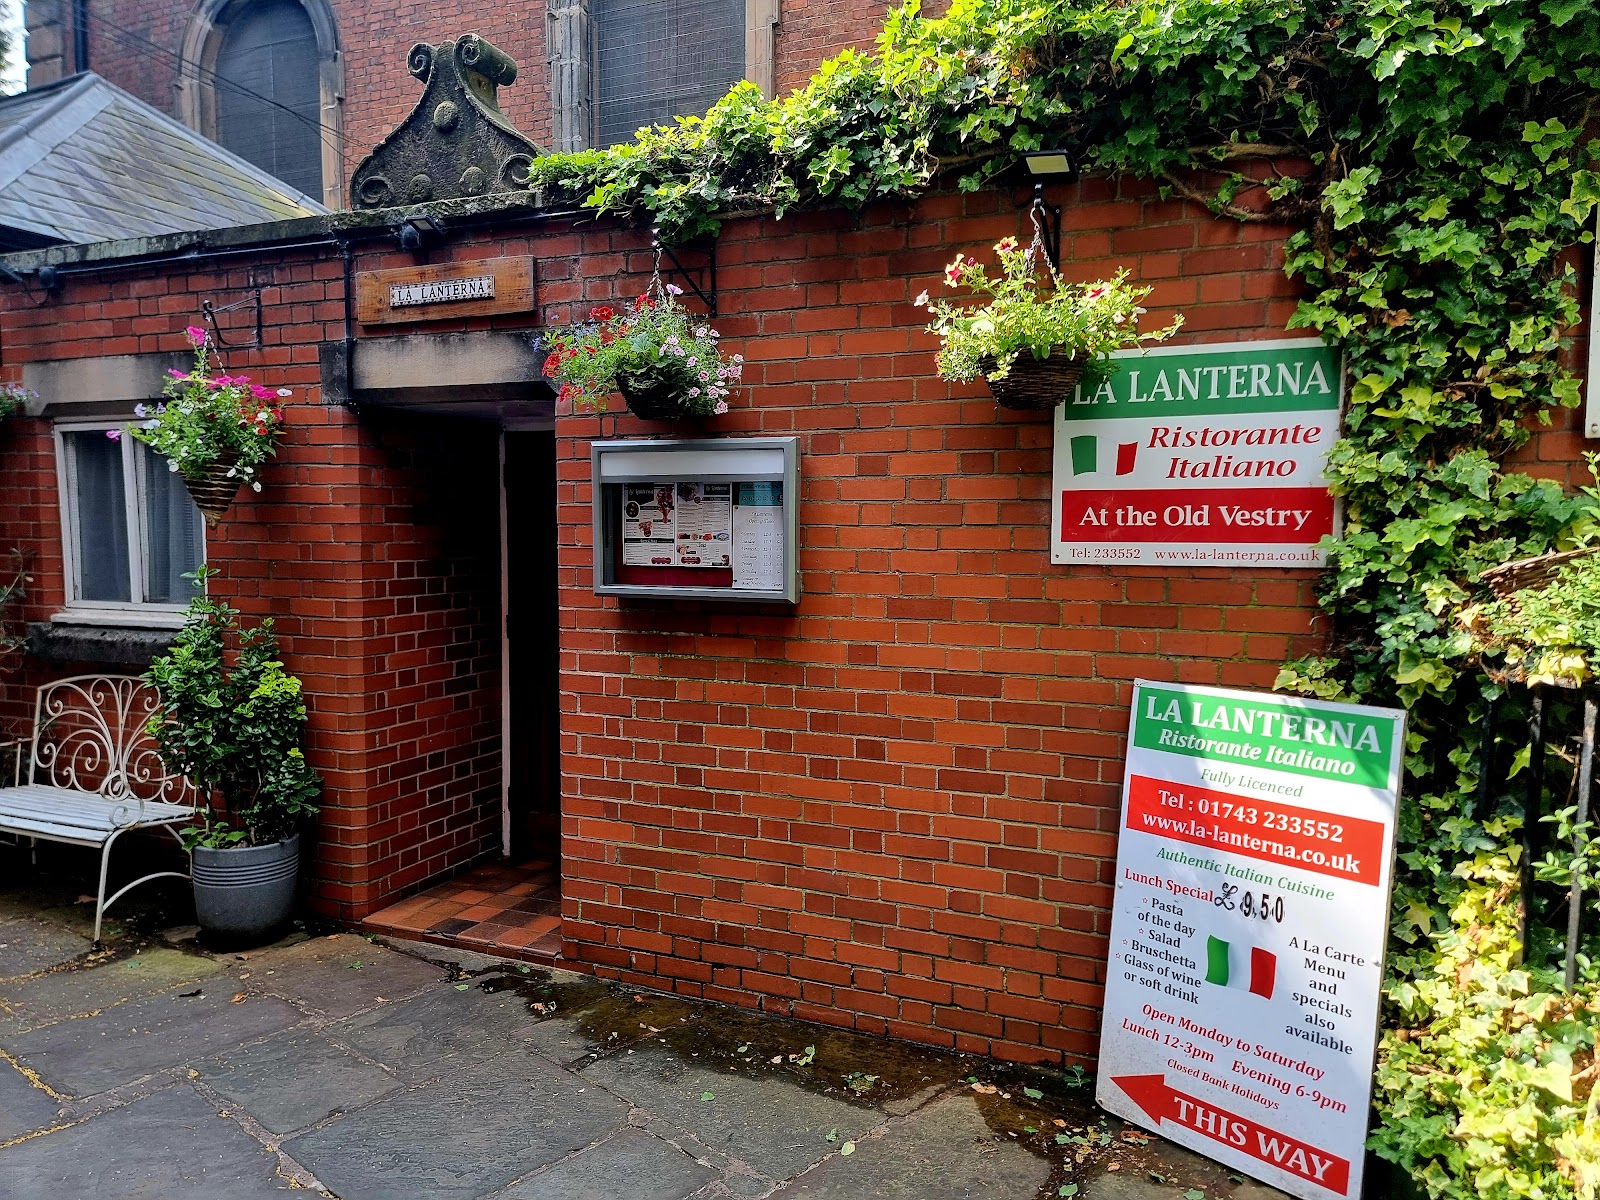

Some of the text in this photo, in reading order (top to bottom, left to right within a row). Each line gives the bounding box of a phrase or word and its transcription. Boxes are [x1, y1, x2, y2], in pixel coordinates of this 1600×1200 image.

[398, 282, 485, 301] LA LANTERNA
[1072, 360, 1332, 406] LA LANTERNA
[1146, 424, 1322, 449] Ristorante
[1166, 455, 1298, 479] Italiano
[1079, 504, 1312, 531] At the Old Vestry
[1070, 548, 1320, 562] Tel: 233552 www.la-lanterna.co.uk
[1145, 696, 1382, 754] LA LANTERNA
[1158, 728, 1356, 776] Ristorante Italiano
[1200, 767, 1304, 798] Fully Licenced
[1158, 789, 1184, 810] Tel
[1198, 799, 1257, 825] 01743
[1263, 811, 1343, 843] 233552
[1142, 812, 1360, 874] www.la-lanterna.co.uk
[1125, 868, 1214, 902] Lunch Special
[1156, 846, 1335, 902] Authentic Italian Cuisine
[1152, 898, 1183, 917] Pasta
[1138, 912, 1196, 938] of the day
[1149, 929, 1181, 948] Salad
[1131, 940, 1197, 970] Bruschetta
[1289, 936, 1366, 967] A La Carte
[1124, 954, 1202, 988] Glass of wine
[1304, 957, 1347, 981] Menu
[1124, 972, 1200, 1005] or soft drink
[1308, 977, 1337, 996] and
[1291, 991, 1353, 1018] specials
[1305, 1012, 1336, 1032] also
[1142, 1003, 1325, 1081] Open Monday to Saturday
[1285, 1023, 1354, 1055] available
[1122, 1018, 1347, 1113] Lunch 12-3pm Evening 6-9pm
[1167, 1058, 1280, 1110] Closed Bank Holidays
[1173, 1096, 1333, 1182] THIS WAY
